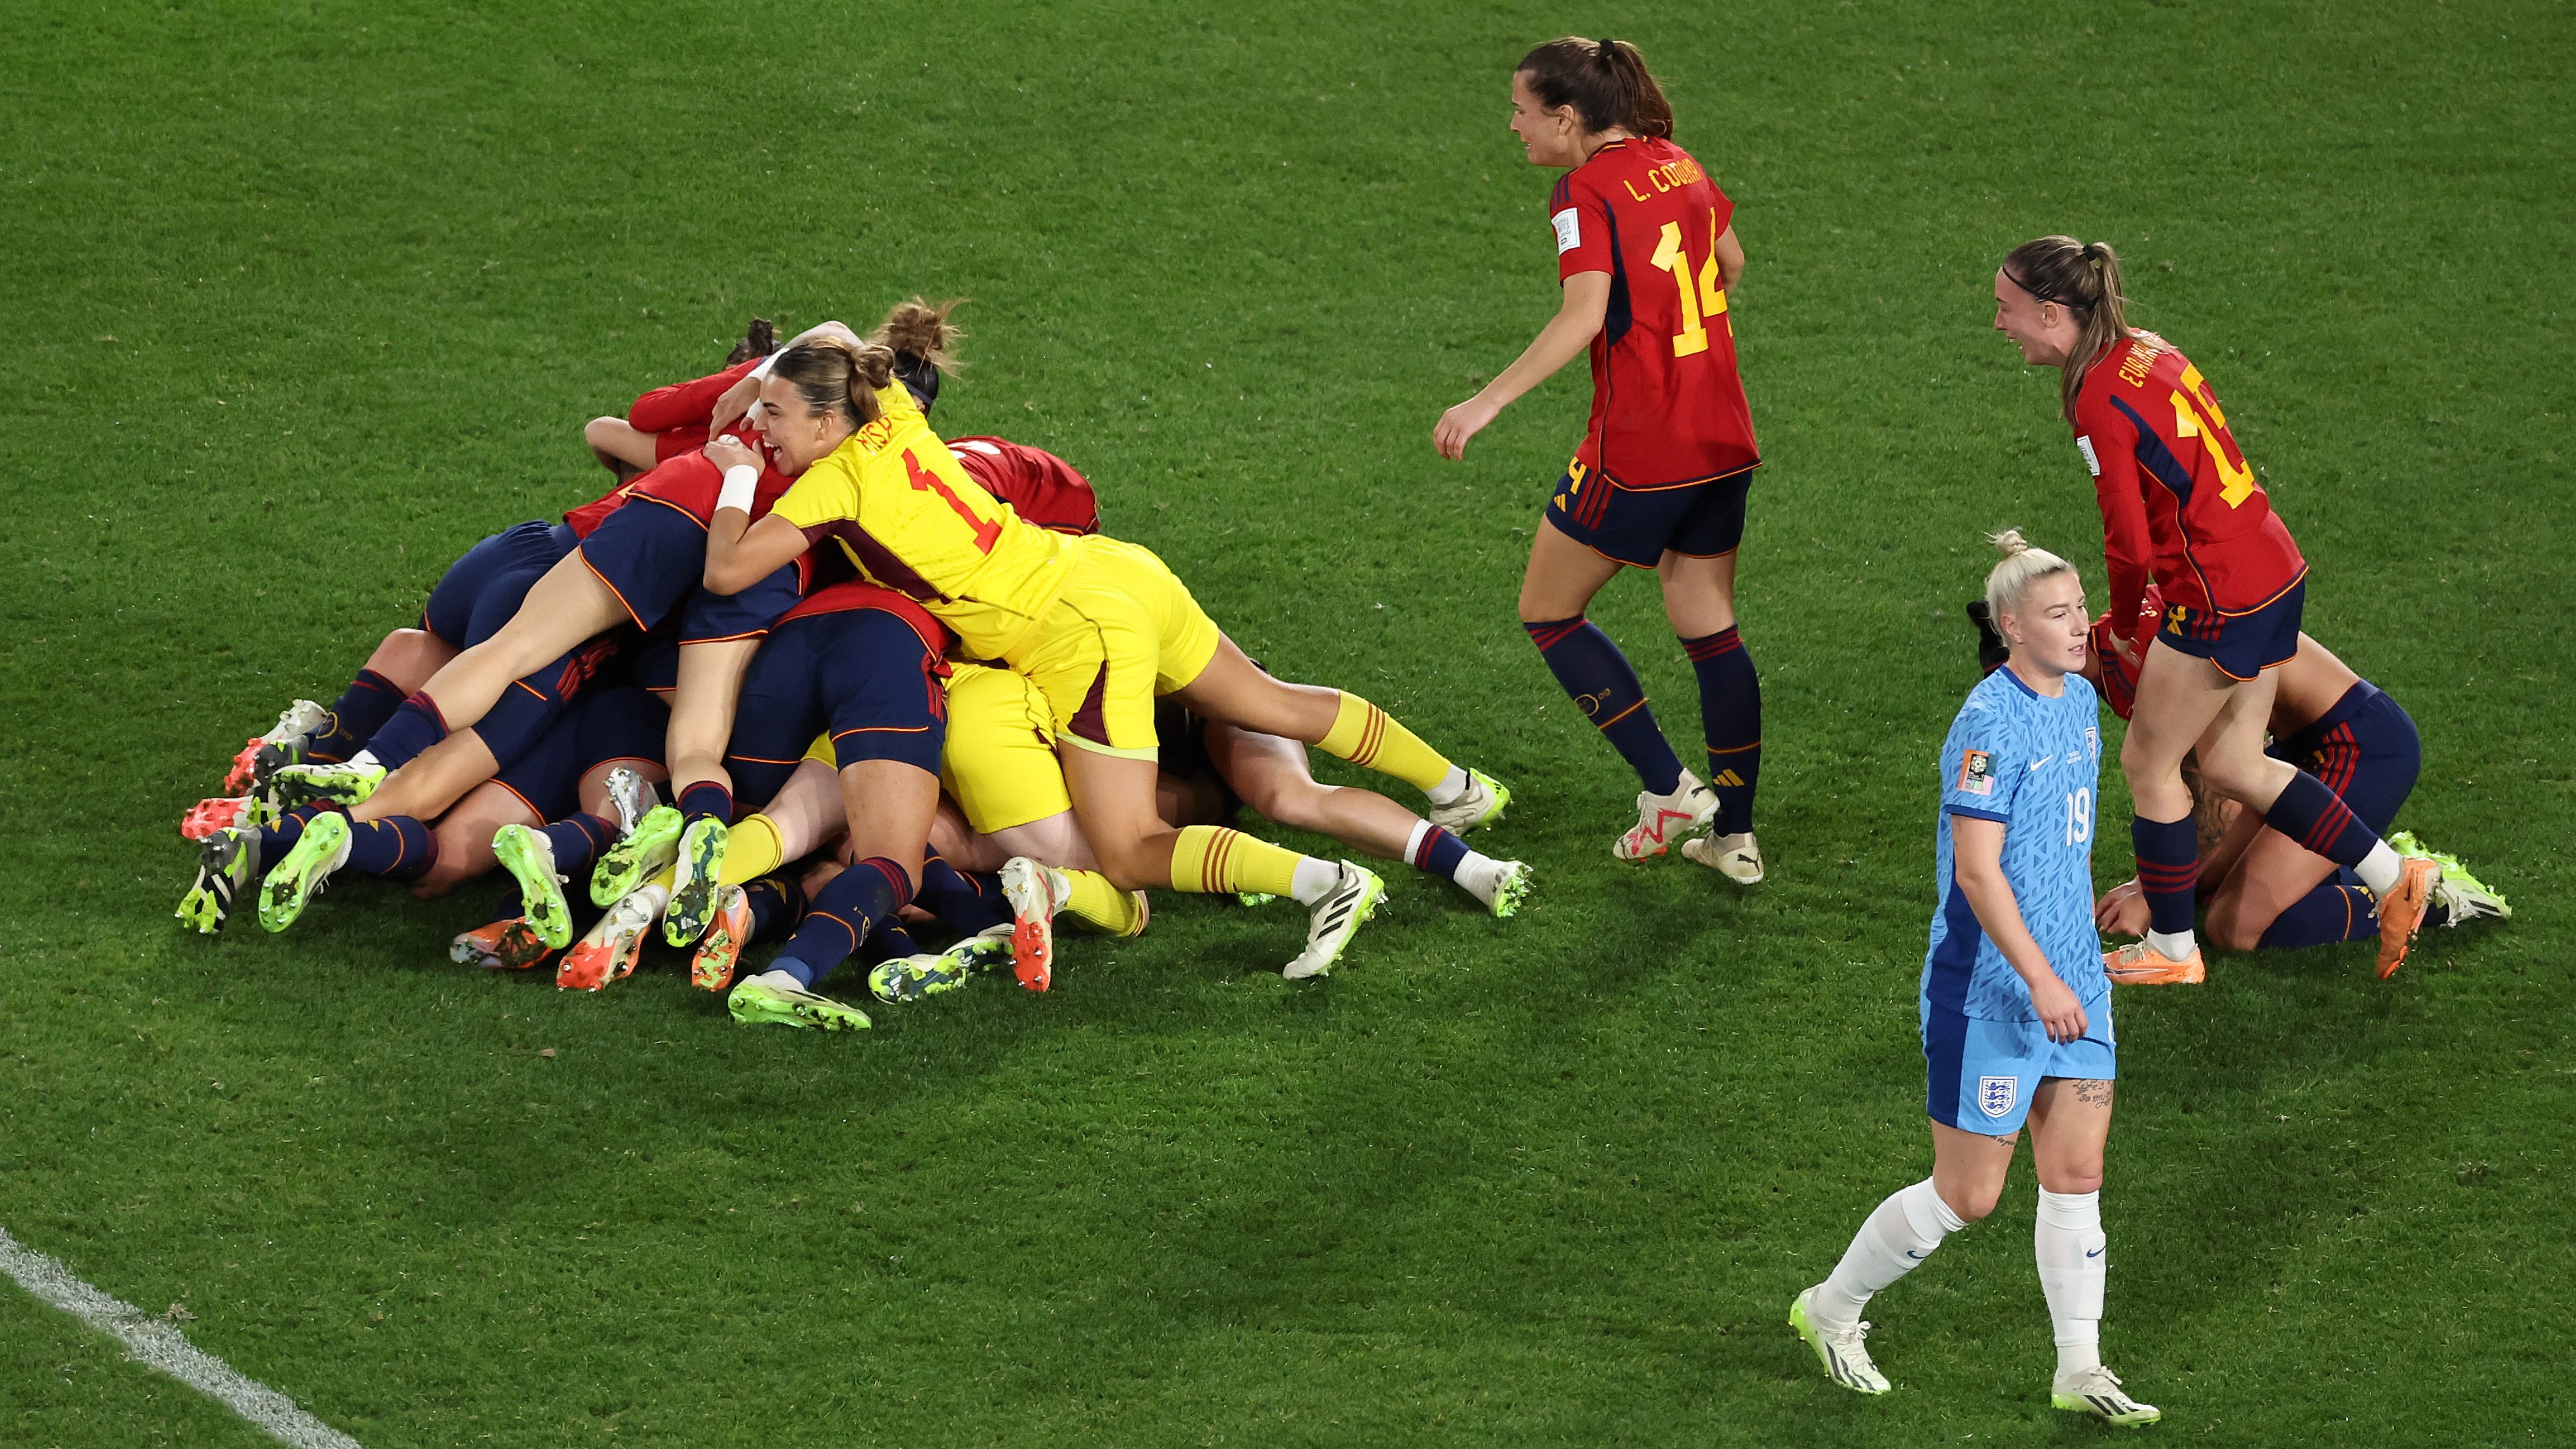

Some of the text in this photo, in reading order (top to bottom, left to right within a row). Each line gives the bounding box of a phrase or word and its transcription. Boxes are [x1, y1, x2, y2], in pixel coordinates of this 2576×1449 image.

[1623, 180, 1651, 202] L.
[1650, 207, 1733, 357] 14
[2118, 356, 2151, 388] EVA
[901, 447, 1003, 556] 1
[2066, 786, 2091, 847] 19
